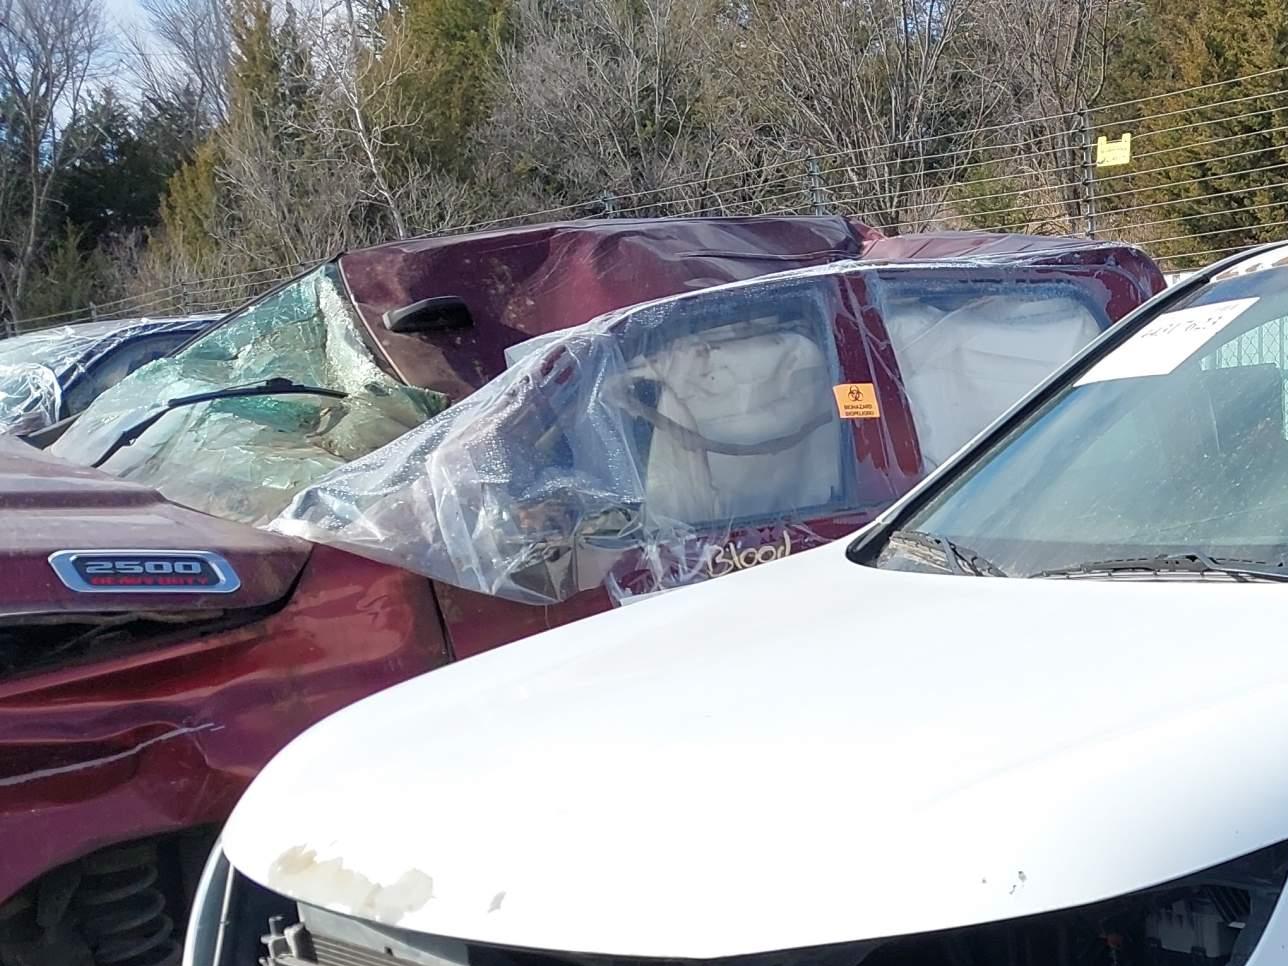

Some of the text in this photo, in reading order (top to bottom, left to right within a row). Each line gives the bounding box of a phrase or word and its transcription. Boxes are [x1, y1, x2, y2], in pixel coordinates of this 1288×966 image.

[706, 529, 792, 578] Blood
[85, 561, 202, 574] 2500
[91, 576, 208, 585] HEAVY DUTY
